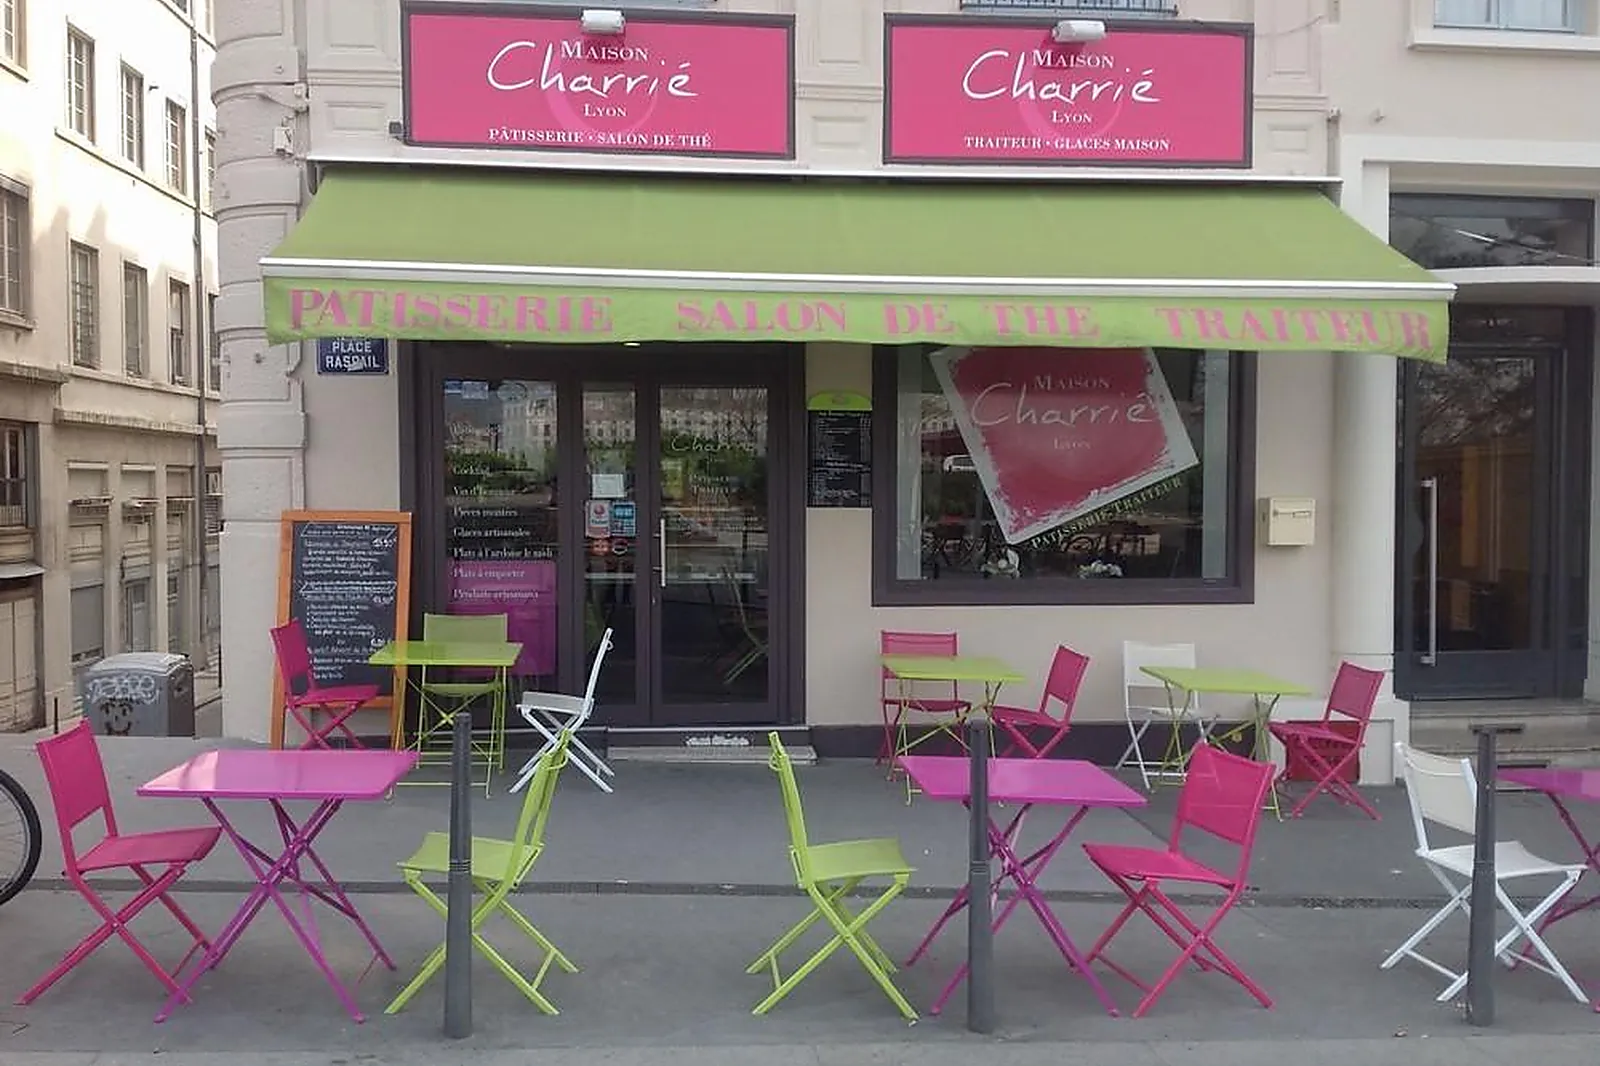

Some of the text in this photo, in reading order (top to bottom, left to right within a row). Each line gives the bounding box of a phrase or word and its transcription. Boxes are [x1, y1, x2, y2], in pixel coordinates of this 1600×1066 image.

[487, 41, 699, 98] Charrié
[962, 50, 1161, 104] Charrié
[489, 126, 711, 147] PÂTISSERIE SALON DE THÉ
[964, 136, 1170, 151] TRAITEUR GLACES MAISON
[288, 288, 1434, 351] PATISSERIE SALON DE THE TRAITEUR
[325, 355, 381, 369] RASPAIL
[332, 340, 372, 353] PLACE
[970, 382, 1153, 428] Charrié
